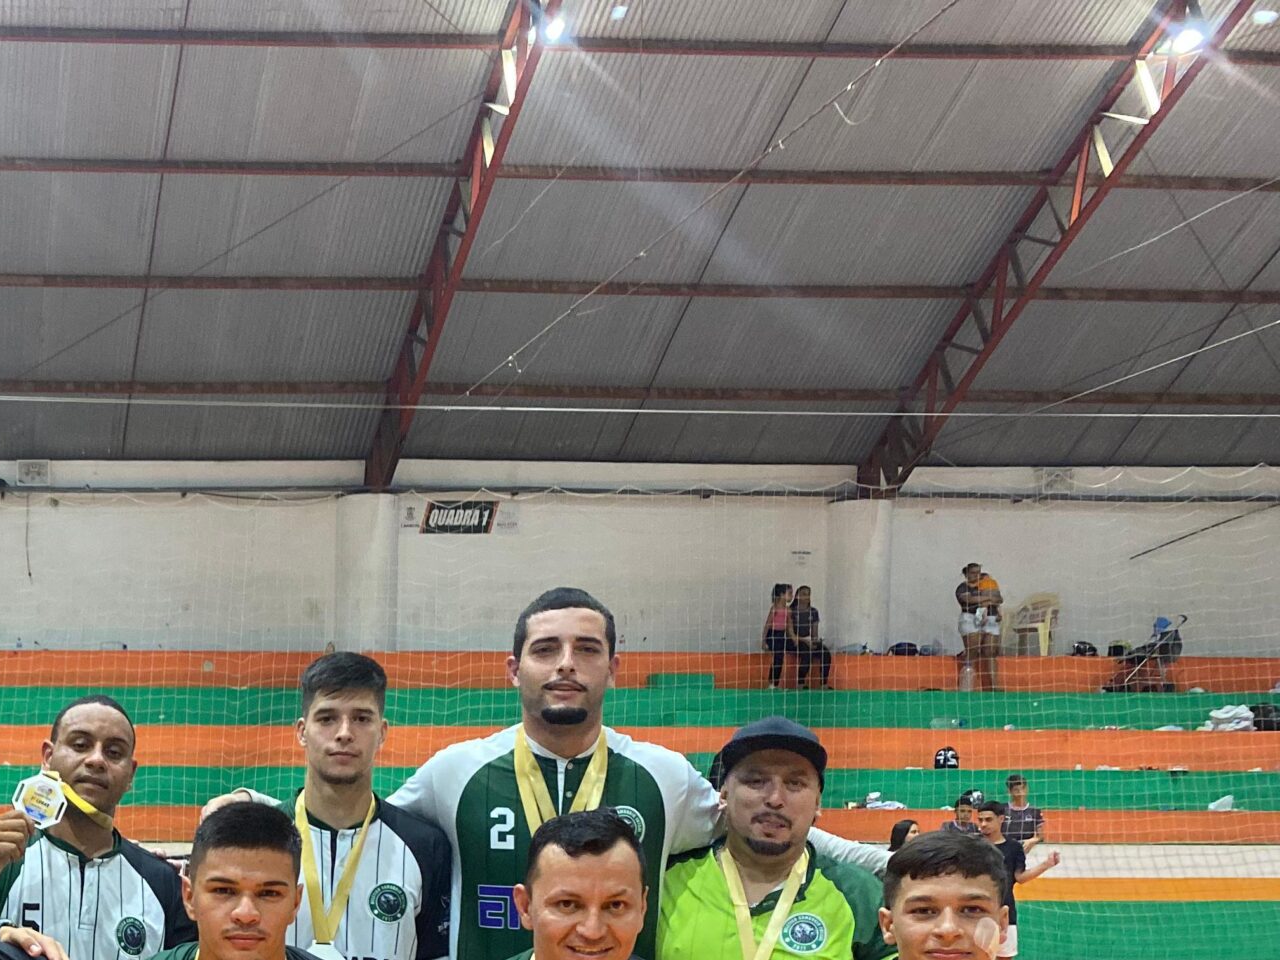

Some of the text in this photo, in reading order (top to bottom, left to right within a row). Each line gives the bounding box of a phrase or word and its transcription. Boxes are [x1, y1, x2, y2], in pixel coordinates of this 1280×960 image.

[429, 509, 490, 527] QUADRA 1
[490, 807, 515, 850] 2
